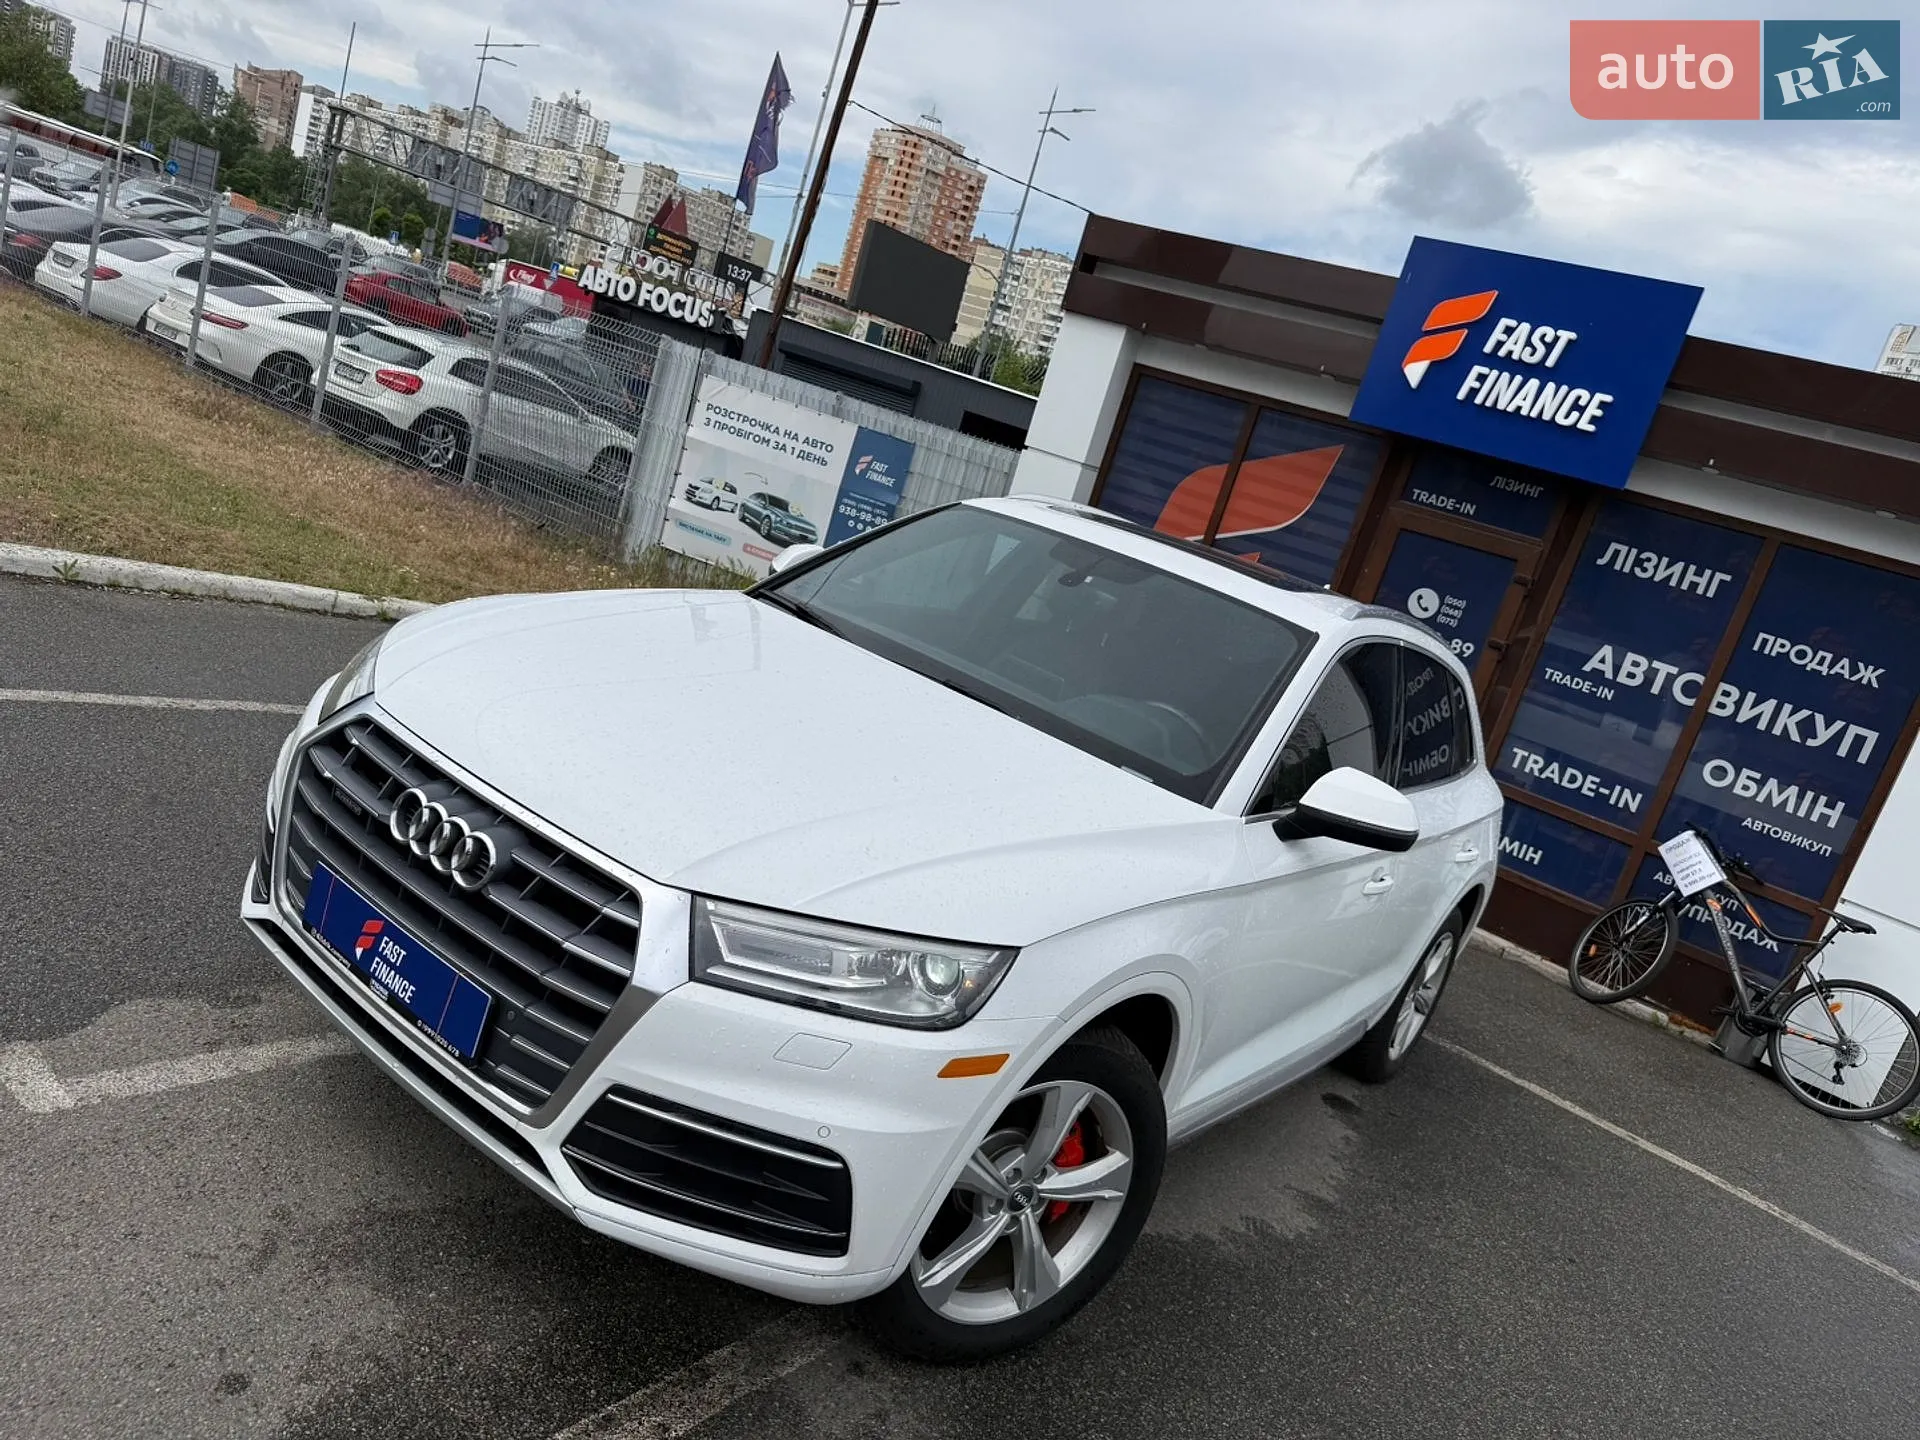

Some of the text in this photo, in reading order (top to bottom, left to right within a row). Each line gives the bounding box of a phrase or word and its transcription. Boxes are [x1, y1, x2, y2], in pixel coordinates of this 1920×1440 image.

[578, 264, 637, 302] АВТО
[638, 280, 718, 329] FOCUS
[727, 264, 753, 282] 13:37
[1482, 317, 1578, 368] FAST
[1456, 365, 1614, 433] FINANCE
[706, 403, 834, 453] РОЗСТРОЧКА НА АВТО
[713, 420, 772, 447] ПРОБІГОМ
[772, 441, 788, 454] ЗА
[790, 446, 796, 456] 1
[796, 449, 828, 467] ДЕНЬ
[865, 470, 896, 488] FINANCE
[870, 461, 889, 473] FAST
[1490, 475, 1544, 499] ЛІЗИНГ
[1412, 488, 1477, 516] TRADE-IN
[1596, 542, 1733, 599] ЛІЗИНГ
[1752, 632, 1887, 689] ПРОДАЖ
[1544, 668, 1615, 701] TRADE-IN
[1582, 644, 1880, 765] АВТОВИКУП
[1512, 747, 1644, 814] TRADE-IN
[1702, 759, 1846, 830] ОБМІН
[1742, 817, 1833, 858] АВТОВИКУП
[379, 935, 407, 967] FAST
[370, 957, 416, 1004] FINANCE
